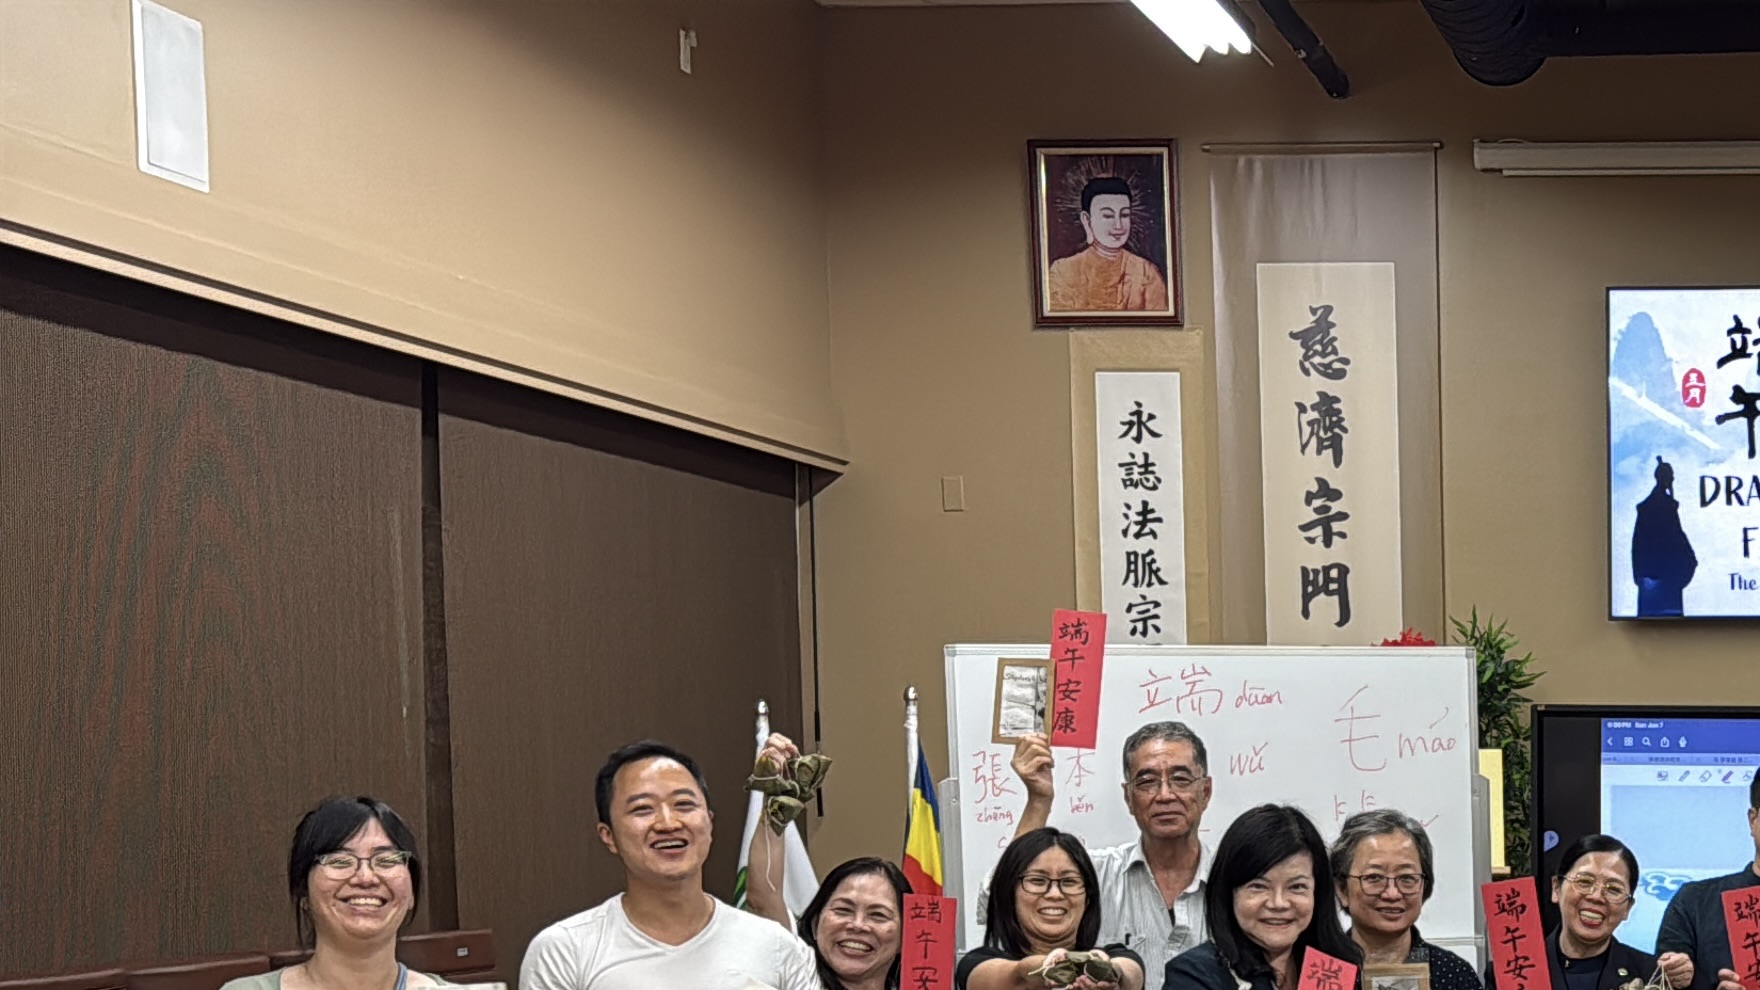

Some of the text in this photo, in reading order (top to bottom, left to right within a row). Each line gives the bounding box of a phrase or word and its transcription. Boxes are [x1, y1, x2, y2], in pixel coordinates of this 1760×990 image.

[1288, 305, 1351, 628] 慈濟宗門
[1118, 400, 1168, 645] 永誌法脈宗
[1728, 572, 1758, 590] The
[1053, 617, 1090, 735] 端午安康
[1139, 663, 1223, 715] 端
[1334, 684, 1387, 772] 毛
